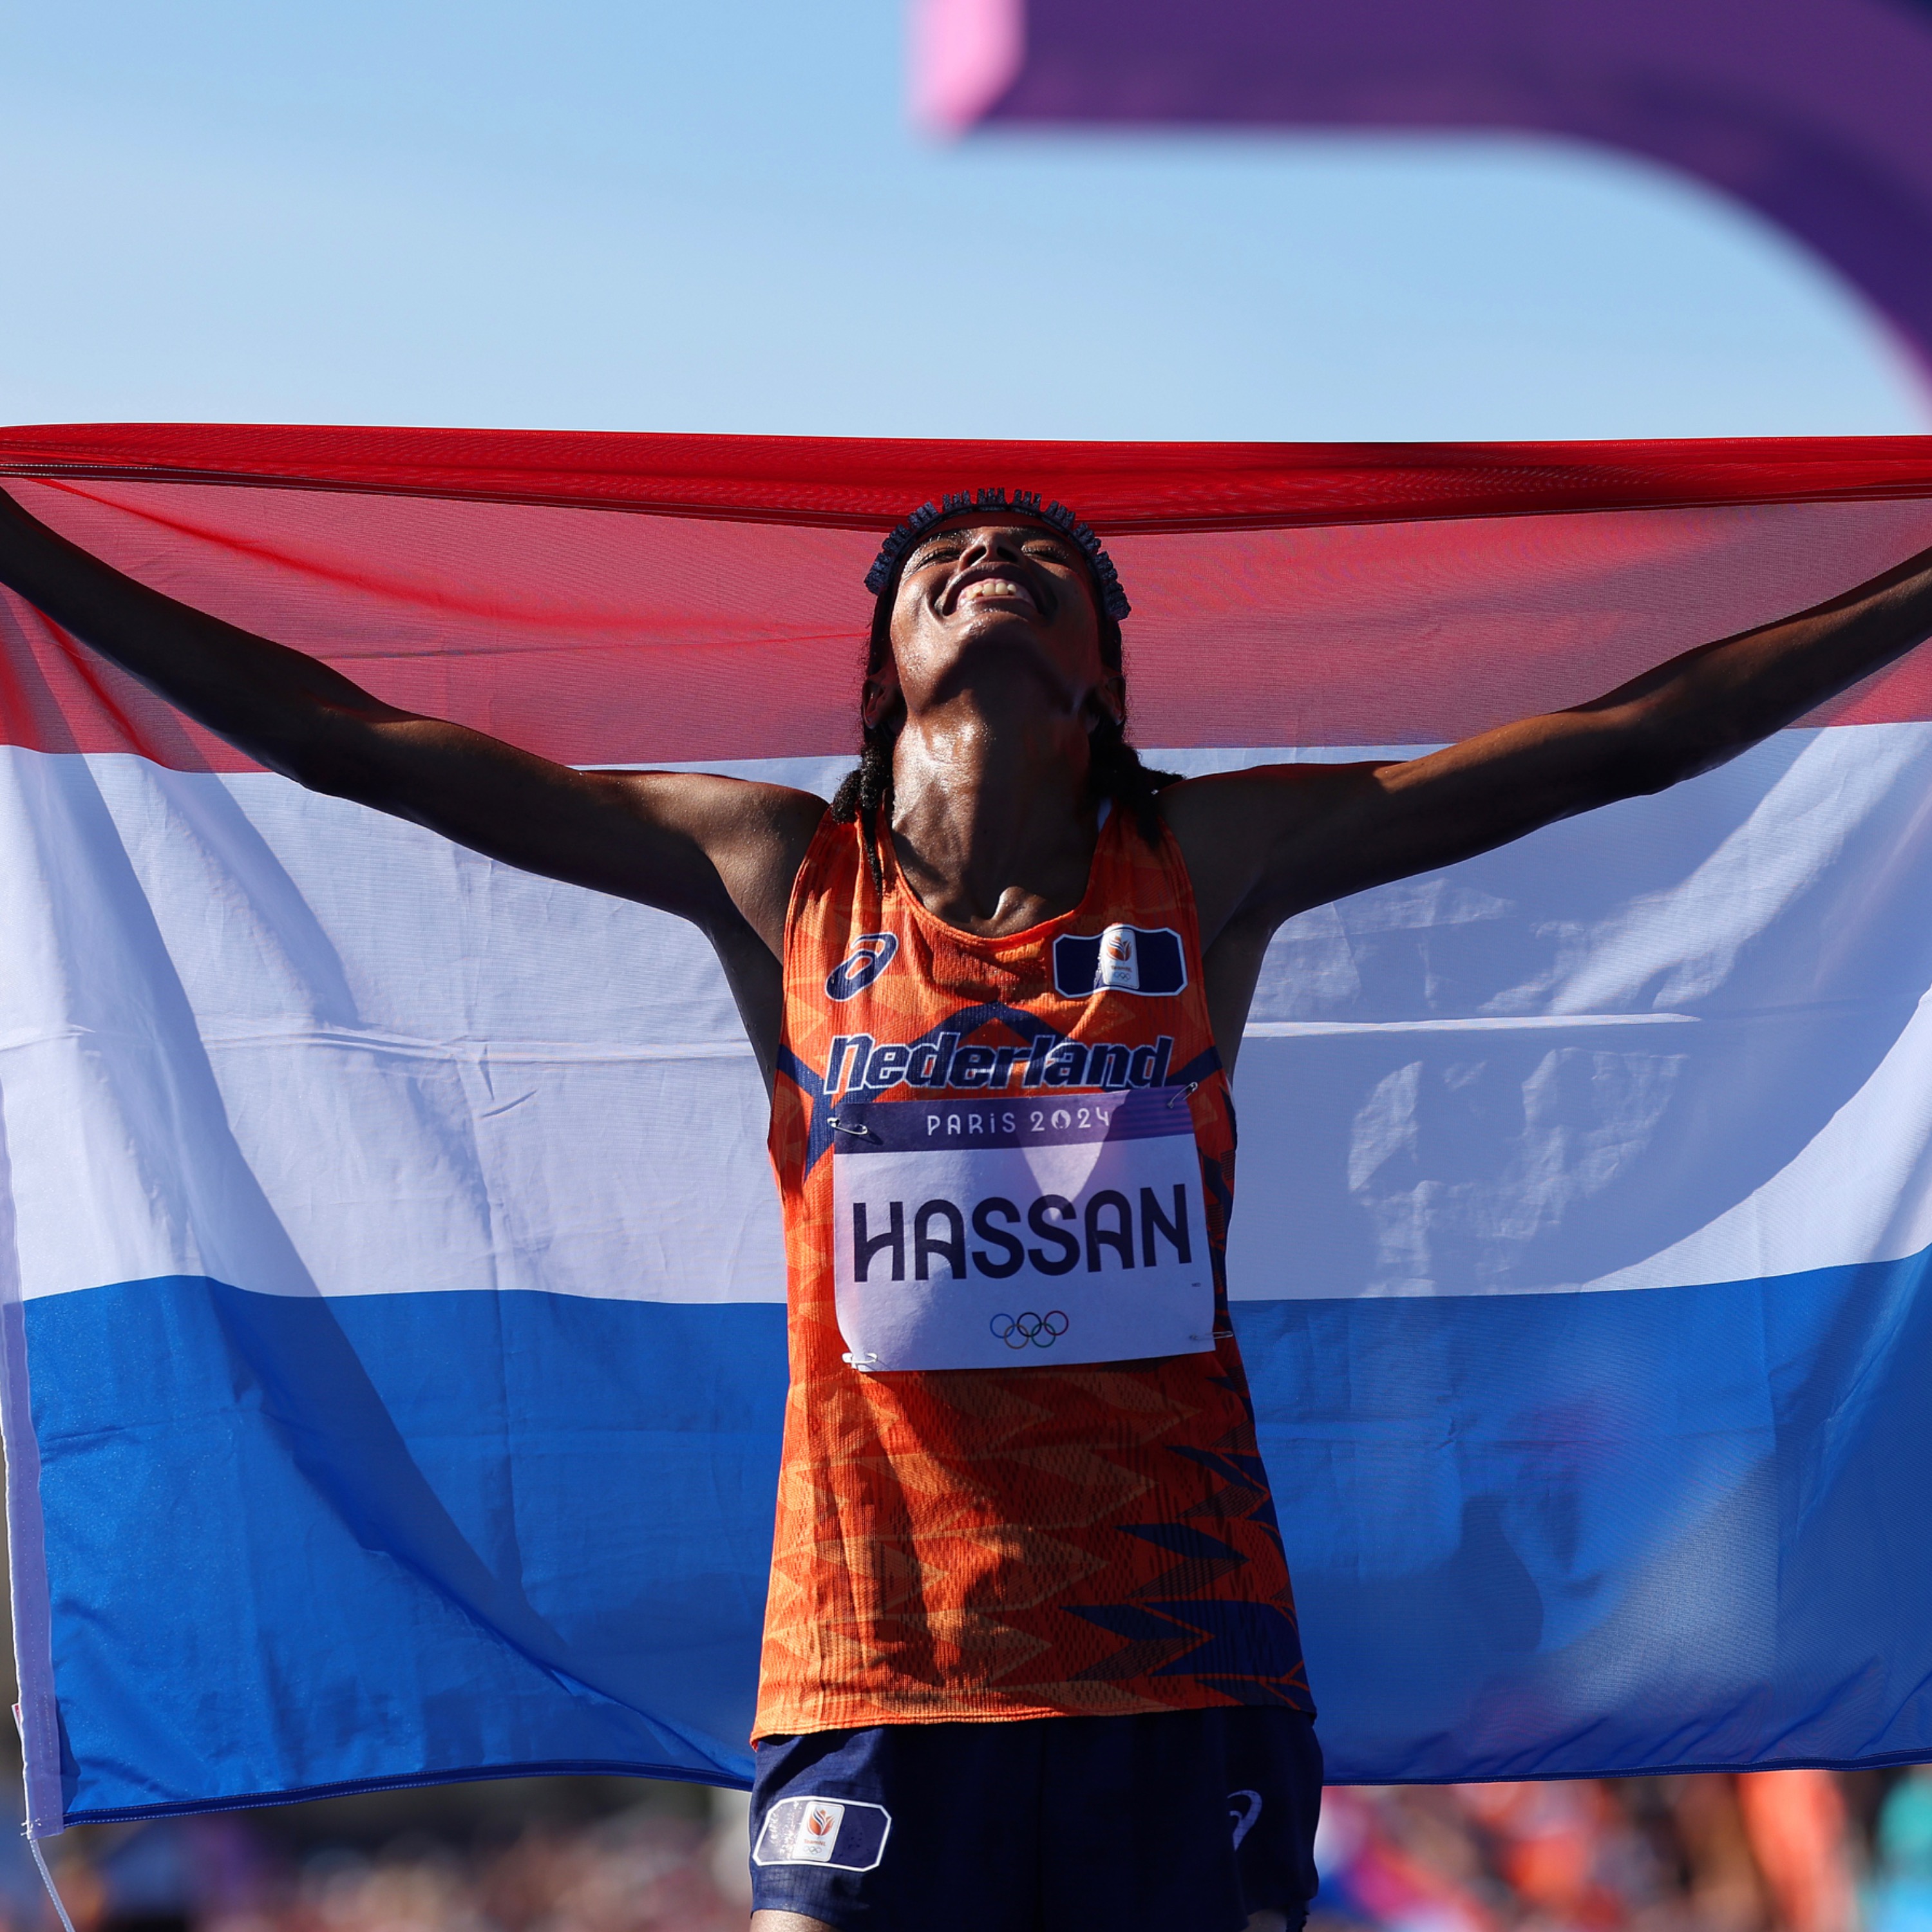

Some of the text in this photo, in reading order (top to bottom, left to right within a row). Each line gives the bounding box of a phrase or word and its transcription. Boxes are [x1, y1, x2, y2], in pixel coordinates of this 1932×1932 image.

[824, 1032, 1174, 1095] Nederland
[1030, 1106, 1110, 1132] 2024
[853, 1183, 1192, 1283] HASSAN
